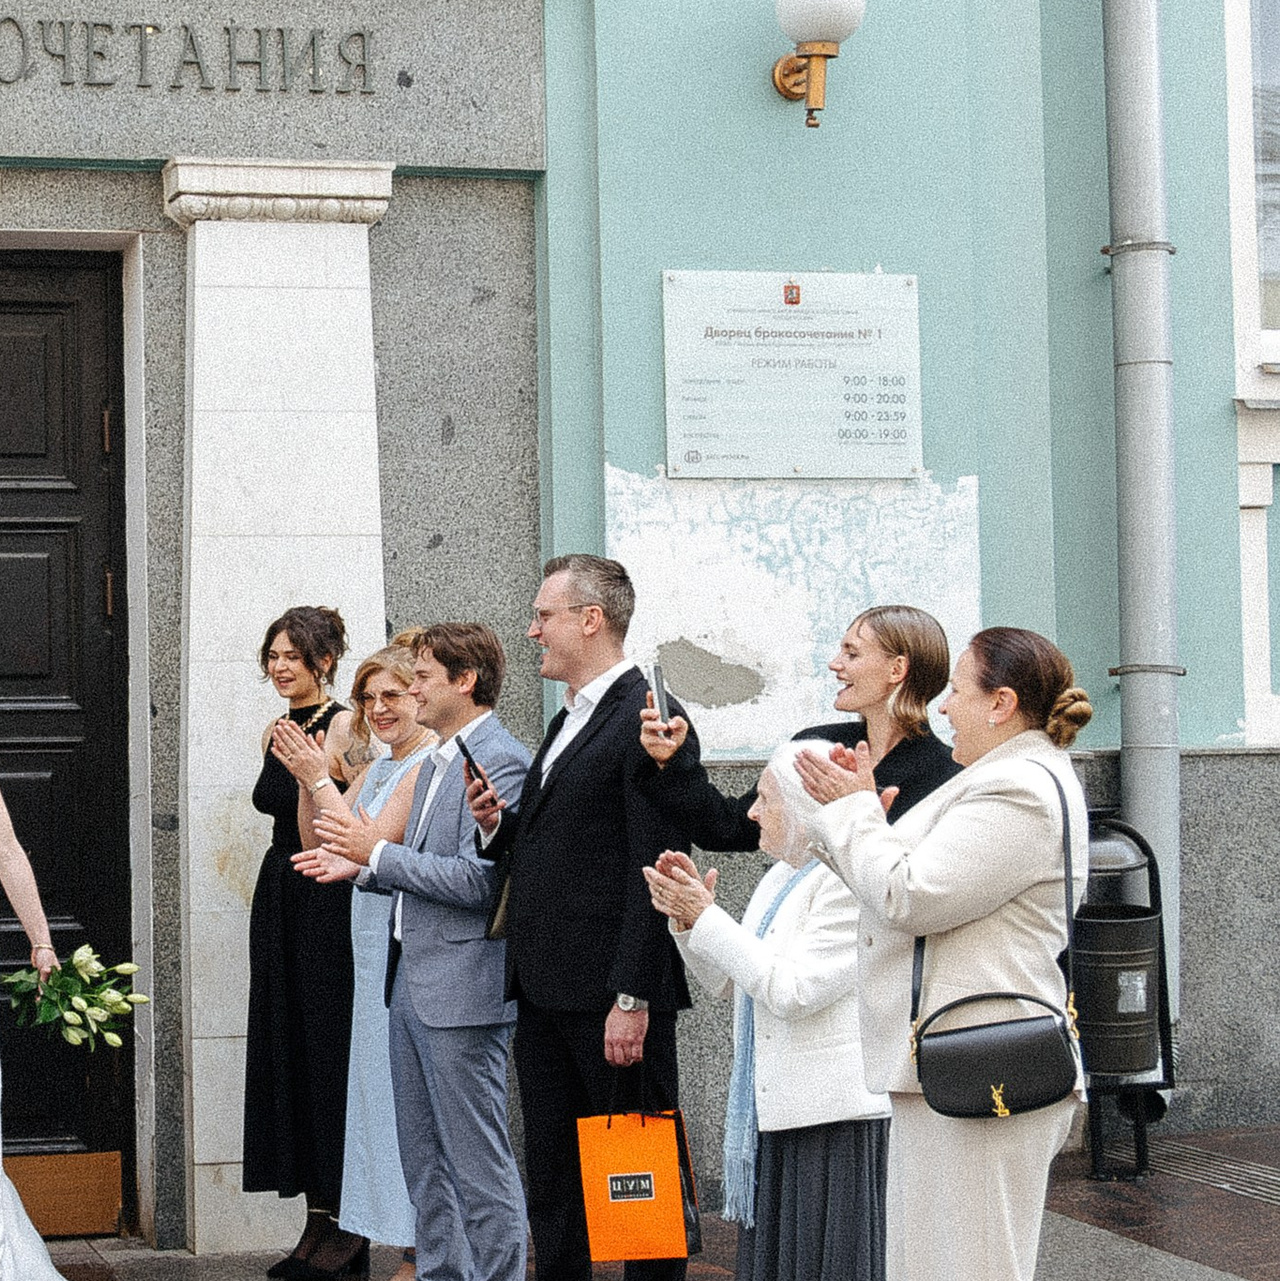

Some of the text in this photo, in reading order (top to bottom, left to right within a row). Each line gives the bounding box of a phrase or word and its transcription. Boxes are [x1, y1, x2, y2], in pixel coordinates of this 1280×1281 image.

[704, 326, 752, 340] Дворец
[877, 328, 882, 339] 1
[751, 358, 837, 370] РЕЖИМ РАБОТЫ
[878, 376, 906, 387] 18:00
[876, 393, 906, 404] 20:00
[879, 428, 907, 439] 19:00
